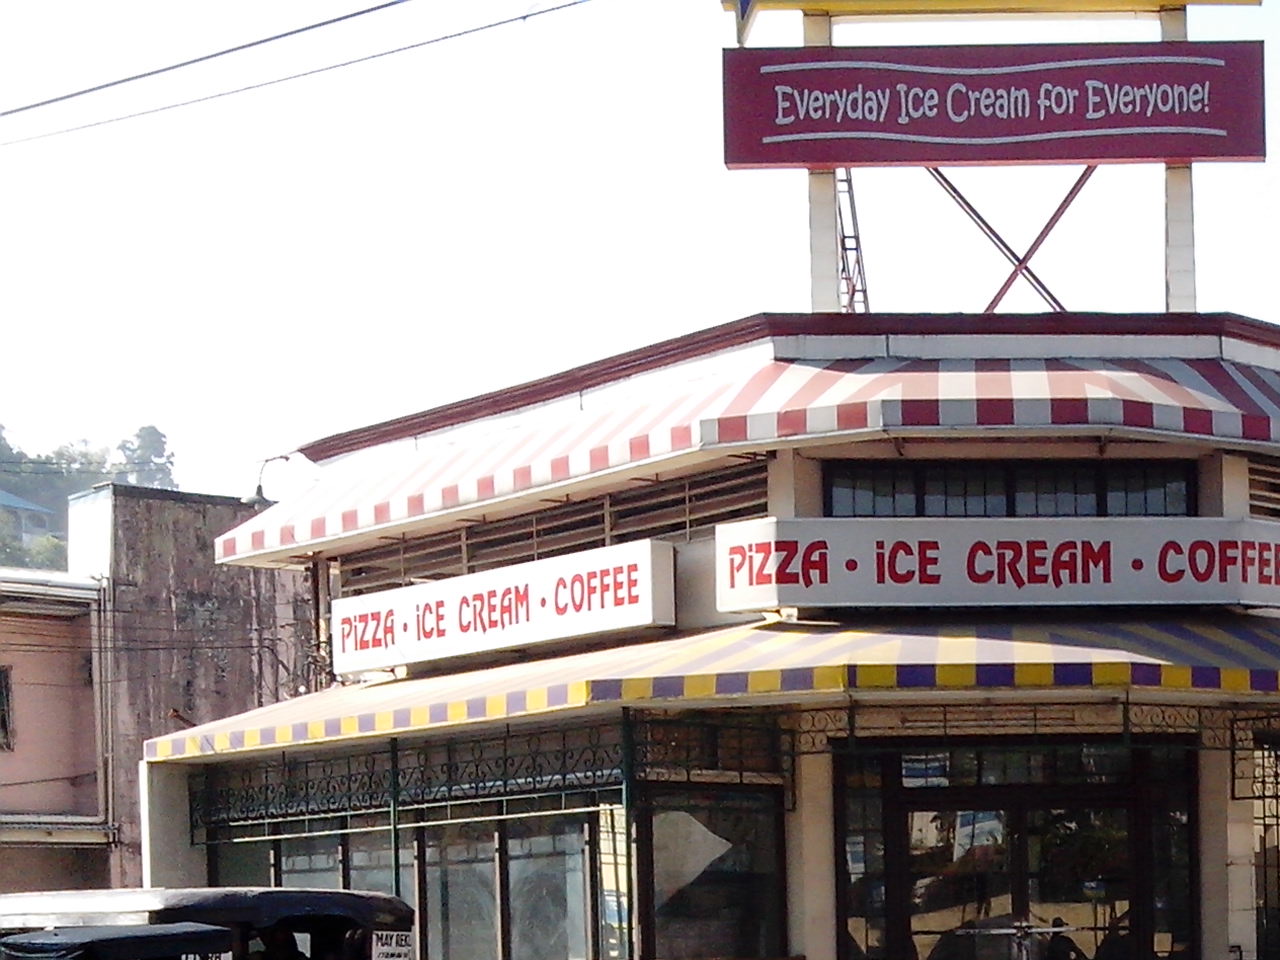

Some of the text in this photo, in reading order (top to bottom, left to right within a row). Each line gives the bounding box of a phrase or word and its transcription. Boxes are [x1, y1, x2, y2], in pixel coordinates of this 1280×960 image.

[774, 79, 1210, 125] Everyday Ice Cream for Everyone!
[967, 540, 1112, 589] CREAM
[458, 583, 530, 634] CREAM
[554, 563, 640, 616] COFFEE
